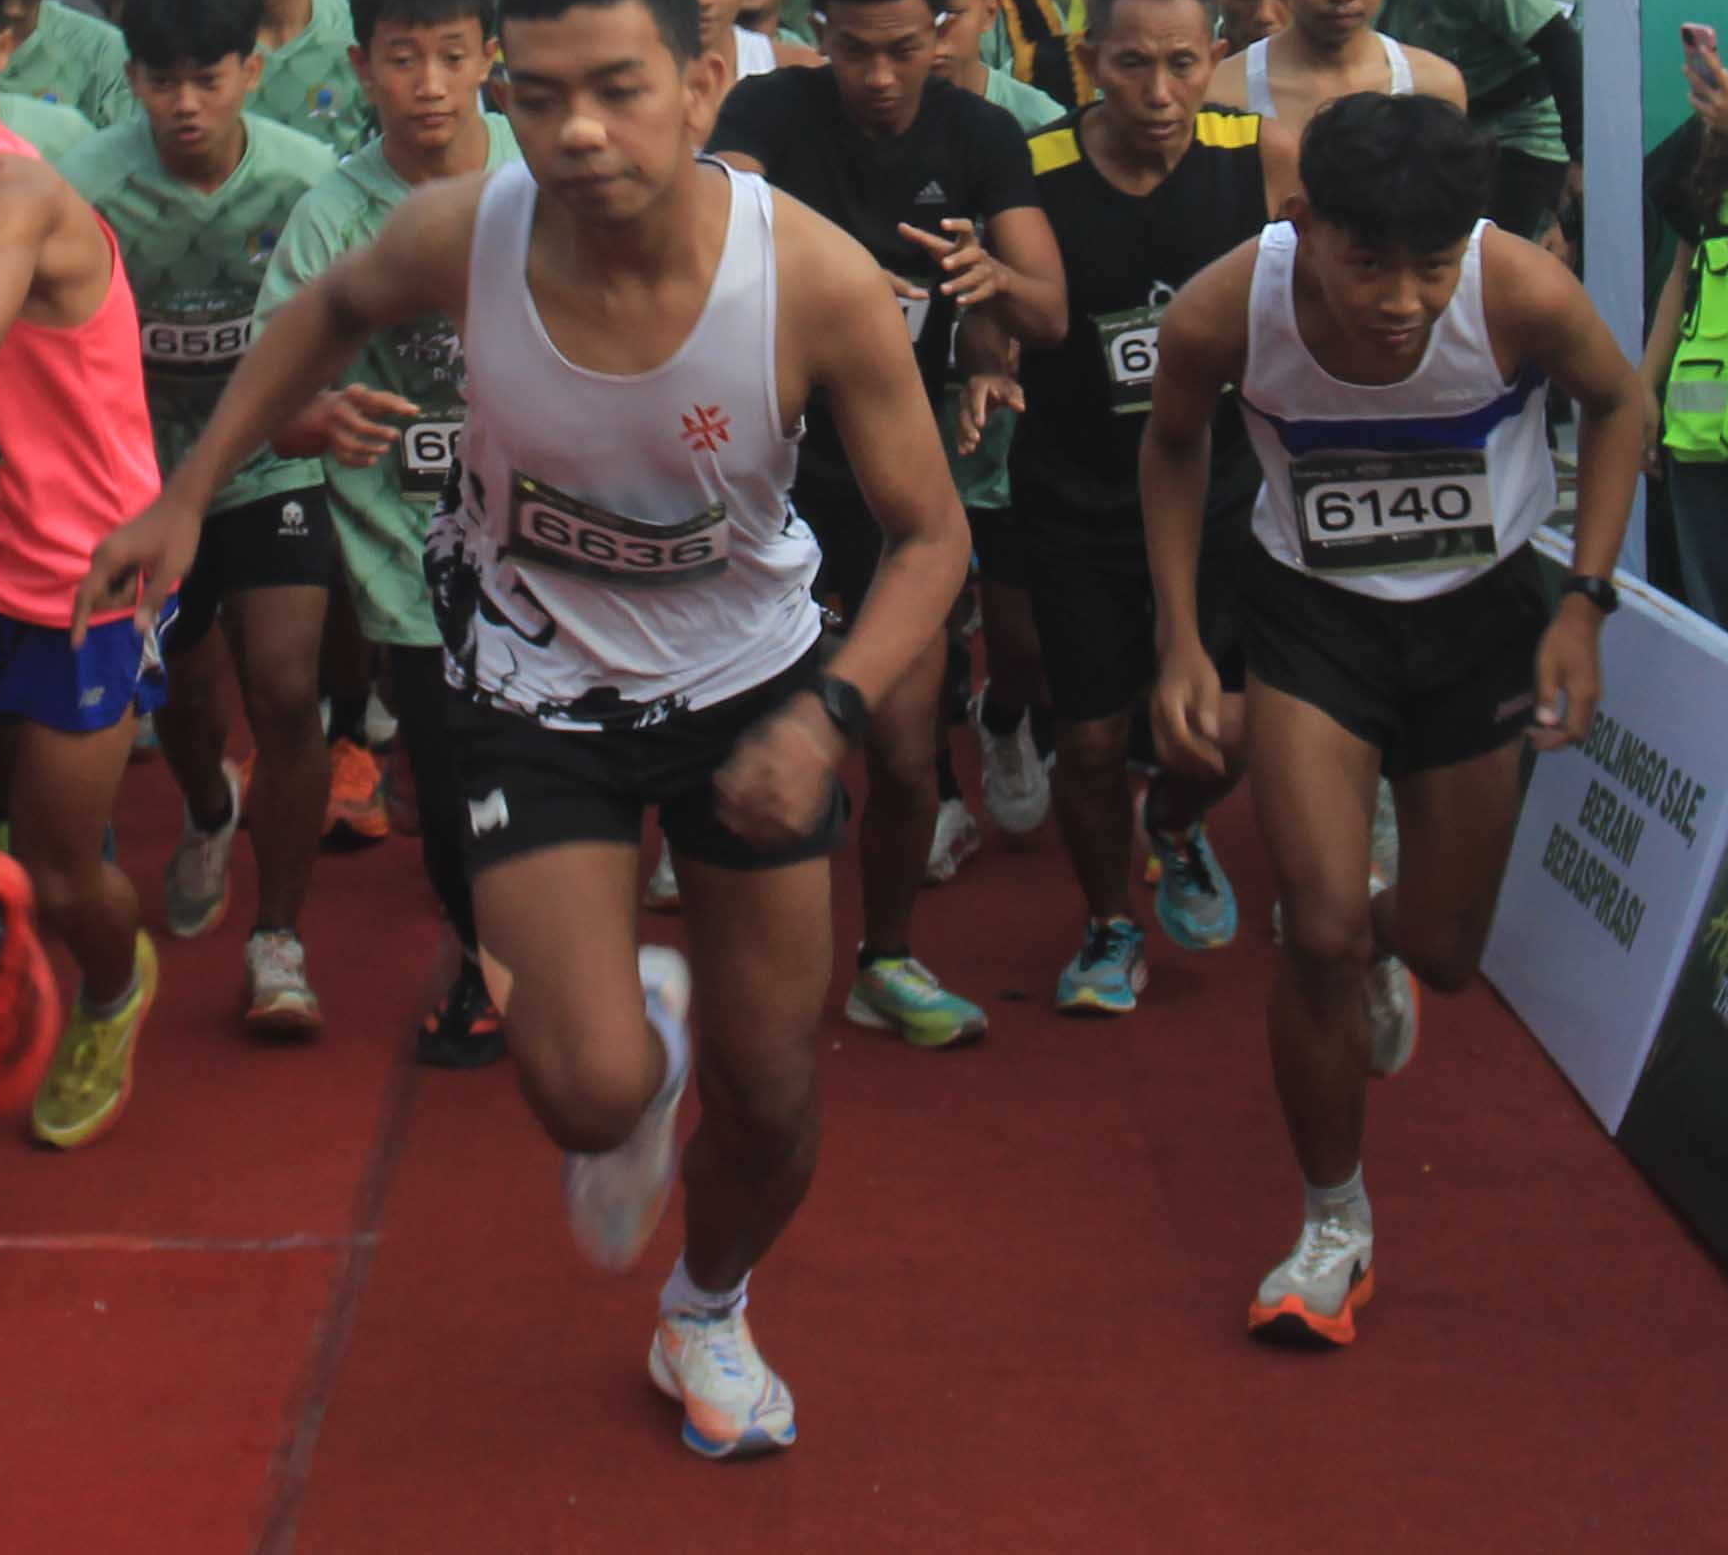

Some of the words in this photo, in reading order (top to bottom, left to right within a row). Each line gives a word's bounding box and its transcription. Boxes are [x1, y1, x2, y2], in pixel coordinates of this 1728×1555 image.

[532, 509, 713, 568] 6636
[1315, 483, 1472, 533] 6140
[1577, 778, 1645, 868] BERANI
[1659, 768, 1707, 850] SAE,
[1541, 822, 1648, 953] BERASPIRASI
